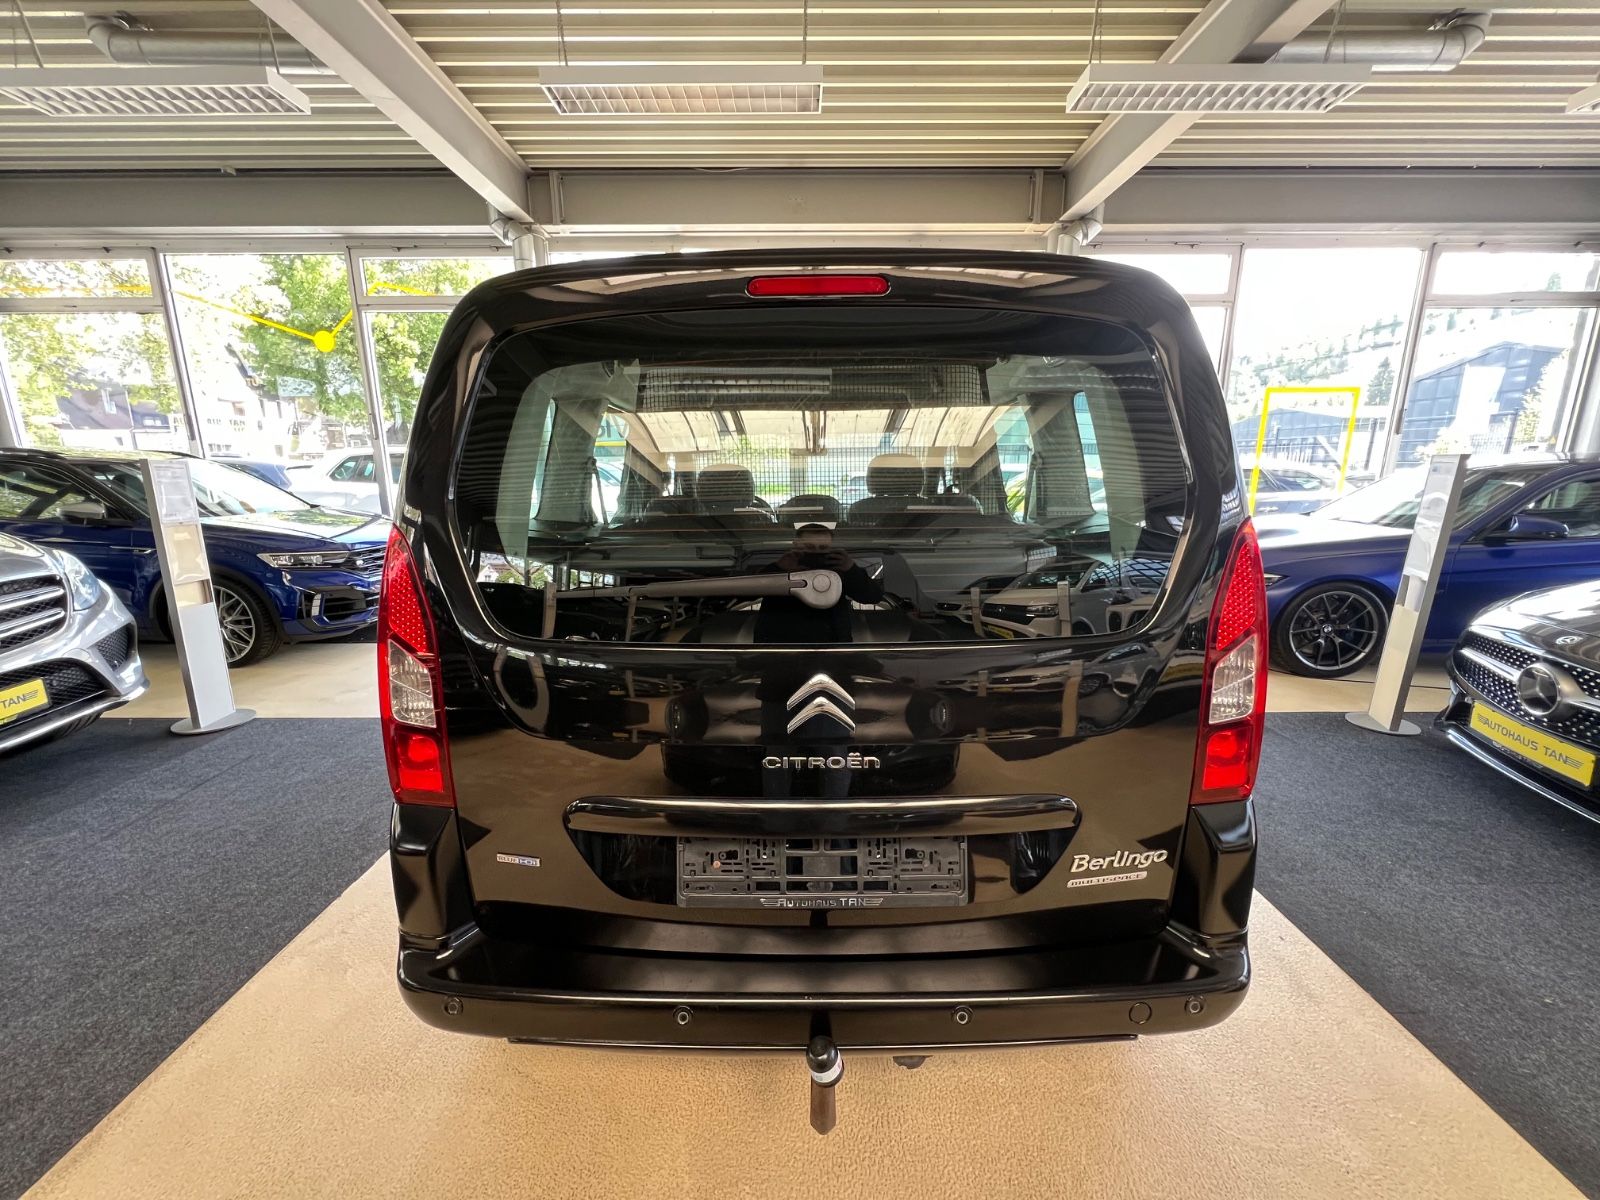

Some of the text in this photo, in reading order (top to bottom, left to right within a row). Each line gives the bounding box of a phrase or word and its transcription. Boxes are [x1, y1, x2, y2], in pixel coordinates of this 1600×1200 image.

[0, 693, 26, 709] TAN
[1484, 717, 1539, 751] AUTOHAUS
[1543, 745, 1568, 765] TAN
[1070, 850, 1168, 873] Berlingo
[778, 898, 866, 907] AUTOHAUS TAN
